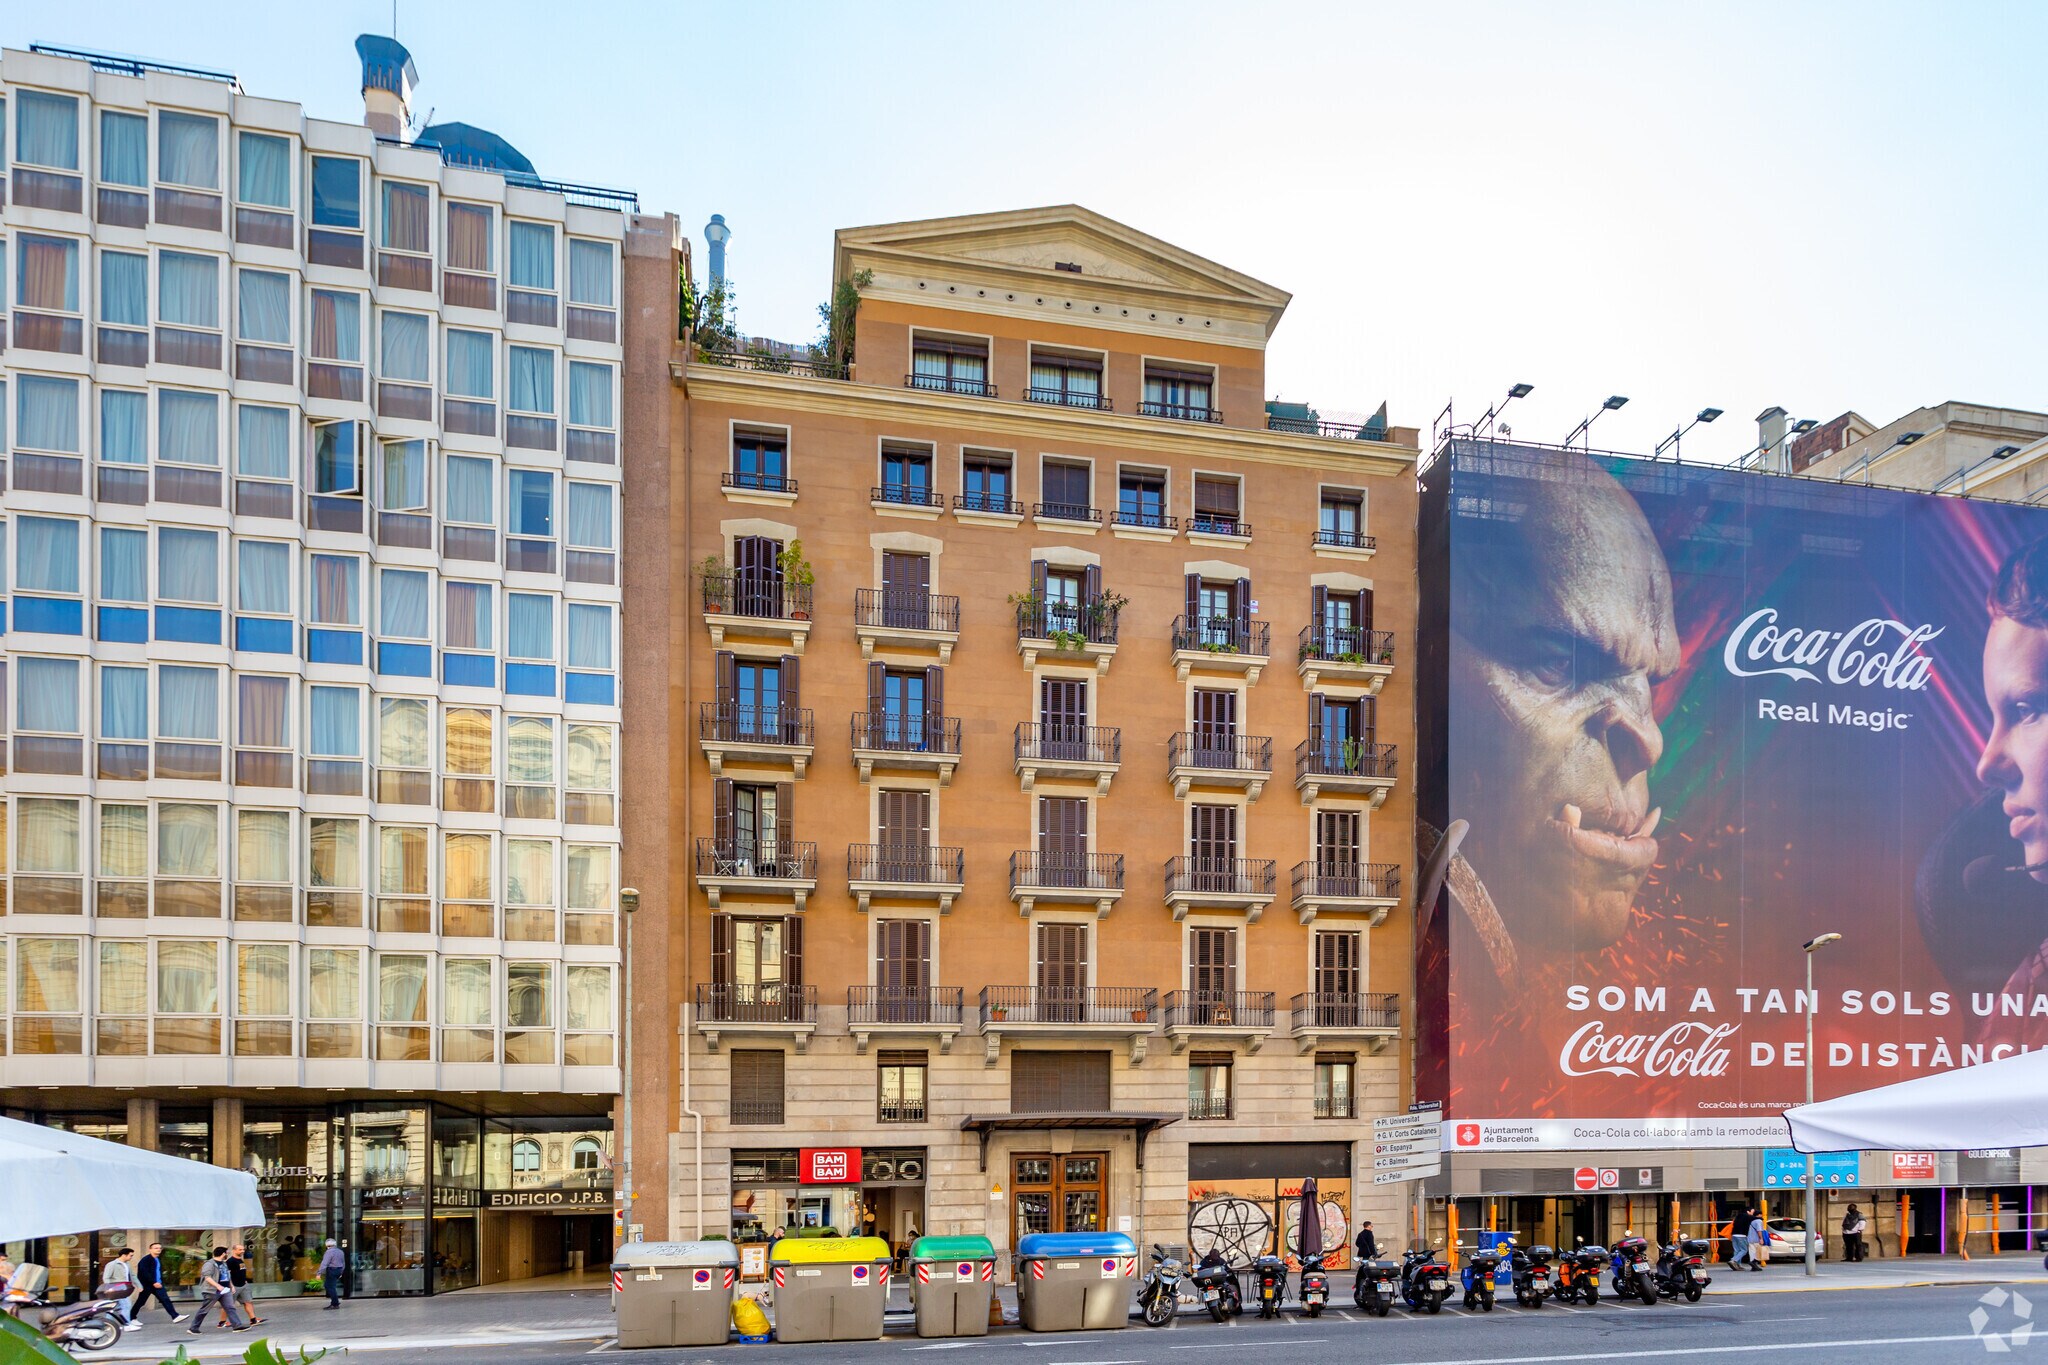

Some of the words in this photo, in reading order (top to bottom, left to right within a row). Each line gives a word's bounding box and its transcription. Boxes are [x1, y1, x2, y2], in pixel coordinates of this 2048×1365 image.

[1724, 608, 1946, 691] Coca-Cola
[1758, 699, 1819, 724] Real
[1566, 985, 1666, 1012] SOM
[1688, 987, 1716, 1013] A
[1735, 988, 1818, 1014] TAN
[1841, 990, 1951, 1015] SOLS
[1971, 992, 2048, 1017] UNA
[1559, 1020, 1742, 1078] Coca-Cola
[1750, 1042, 1806, 1067] DE
[1418, 1102, 1439, 1110] Universitat
[1738, 1101, 1749, 1109] és
[1389, 1115, 1420, 1125] Universitat
[1394, 1130, 1409, 1138] Corts
[1409, 1127, 1437, 1136] Catalanes
[1483, 1126, 1533, 1135] Ajuntament
[1573, 1127, 1631, 1138] Coca-Cola
[1633, 1127, 1687, 1138] col·labora
[1689, 1126, 1713, 1137] amb
[1715, 1126, 1725, 1137] la
[1484, 1135, 1495, 1143] de
[1496, 1135, 1540, 1143] Barcelona
[1389, 1144, 1413, 1152] Espanya
[816, 1155, 843, 1164] BAM
[1389, 1157, 1408, 1166] Balmes
[1894, 1153, 1933, 1167] DEFI
[263, 1166, 317, 1177] HOTEL
[816, 1167, 843, 1177] BAM
[1388, 1172, 1402, 1180] Pelai
[491, 1192, 563, 1206] EDIFICIO
[569, 1191, 607, 1205] J.P.B.
